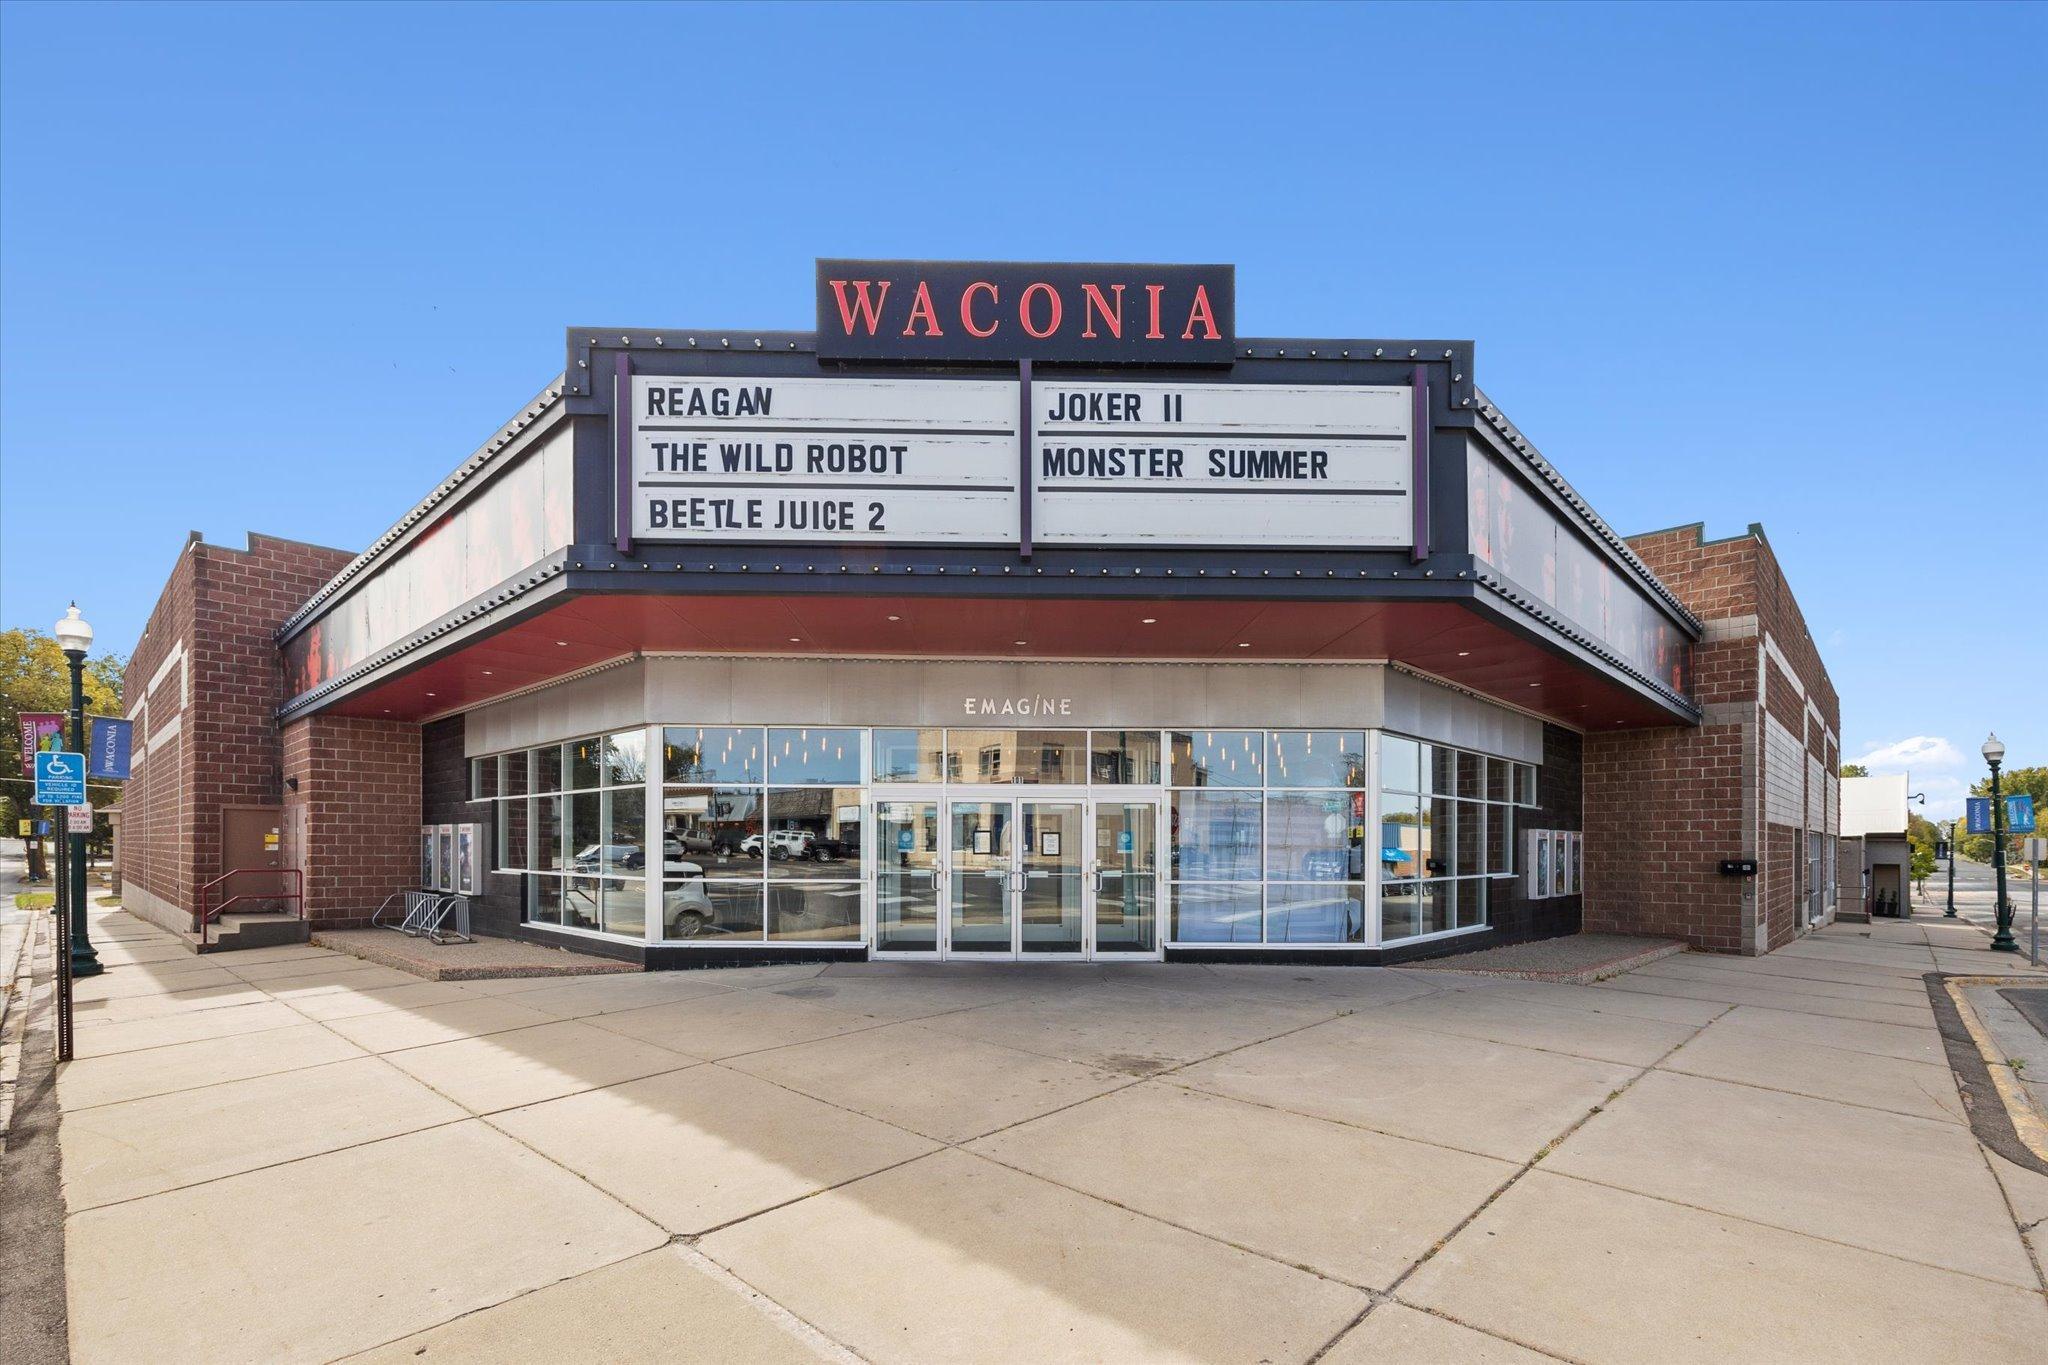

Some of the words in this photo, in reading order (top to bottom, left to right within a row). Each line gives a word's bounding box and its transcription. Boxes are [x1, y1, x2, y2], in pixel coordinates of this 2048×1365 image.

[829, 280, 1222, 340] WACONIA
[648, 386, 773, 416] REAGAN
[1048, 392, 1141, 422] JOKER
[1163, 394, 1183, 422] II
[651, 442, 708, 472] THE
[719, 443, 793, 473] WILD
[807, 444, 908, 475] ROBOT
[1042, 447, 1184, 478] MONSTER
[1208, 448, 1328, 480] SUMMER
[649, 497, 763, 530] BEETLE
[774, 499, 854, 531] JUICE
[868, 502, 886, 531] 2
[23, 720, 33, 762] WELCOME
[105, 724, 118, 768] WACONIA
